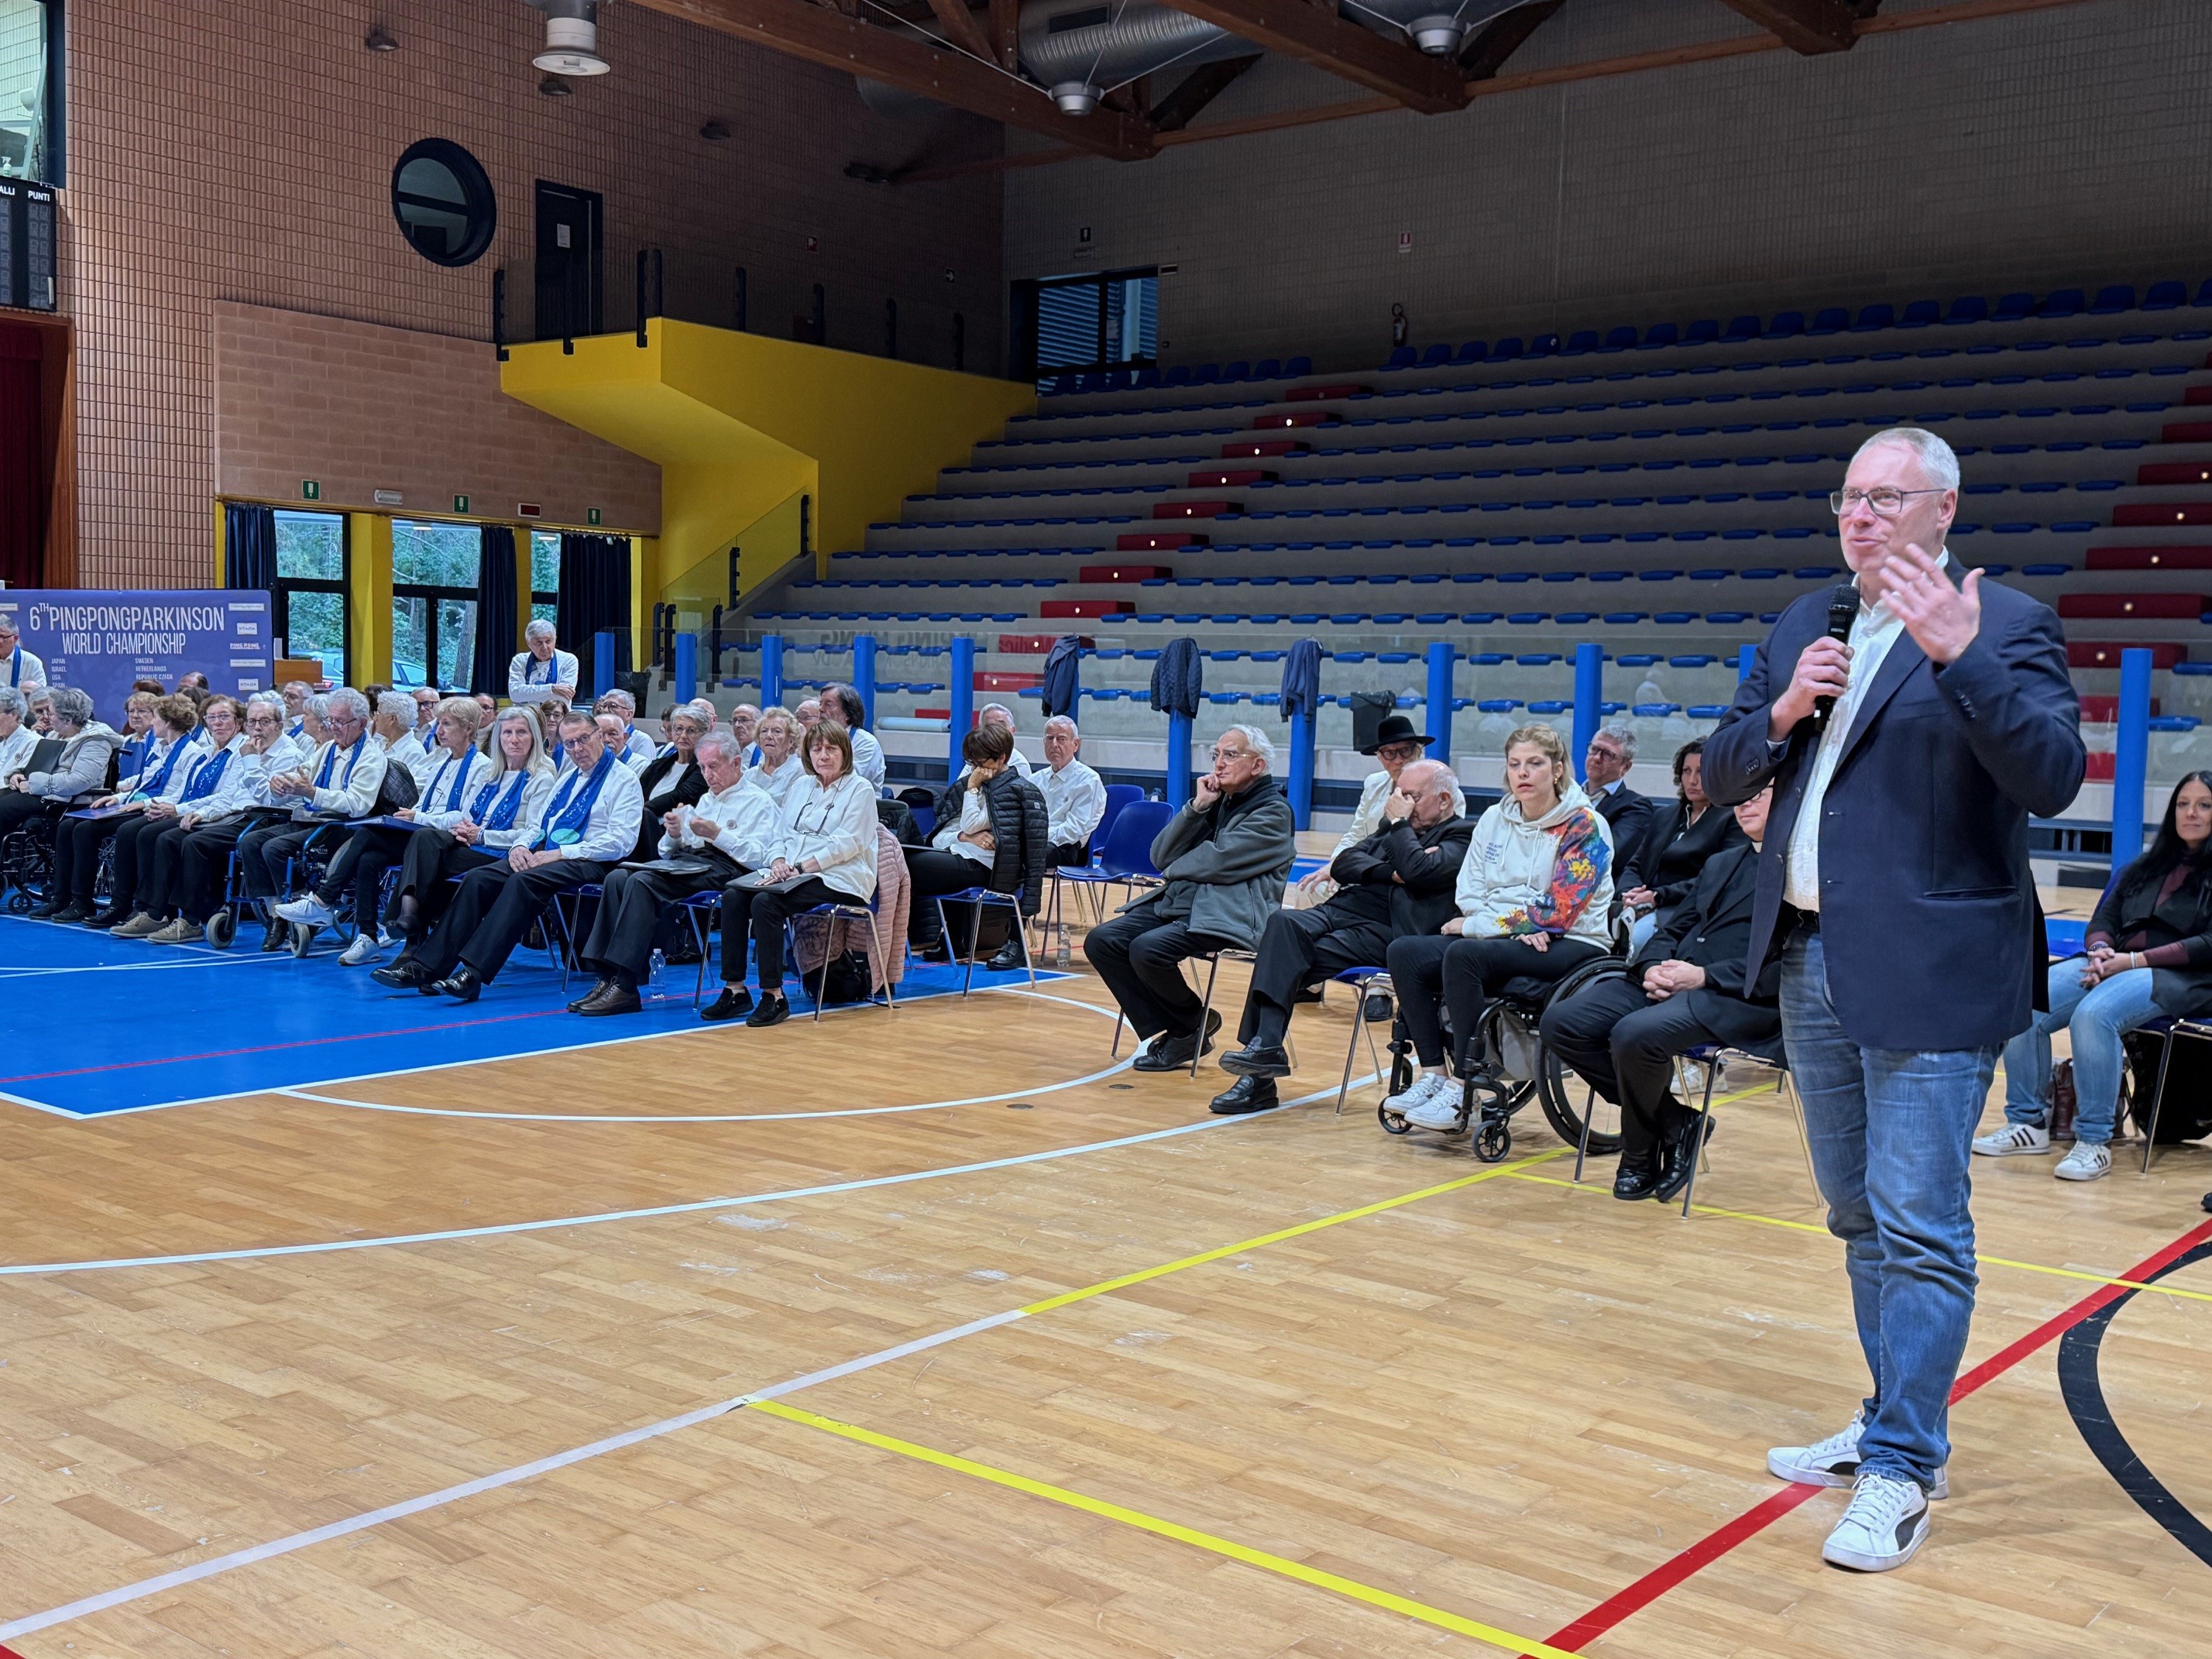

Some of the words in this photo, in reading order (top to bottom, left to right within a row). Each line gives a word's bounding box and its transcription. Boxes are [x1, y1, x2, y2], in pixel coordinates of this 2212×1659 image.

[28, 190, 50, 201] PUNTI
[50, 606, 225, 631] PINGPONGPARKINSON
[62, 633, 101, 654] WORLD
[106, 632, 186, 654] CHAMPIONSHIP
